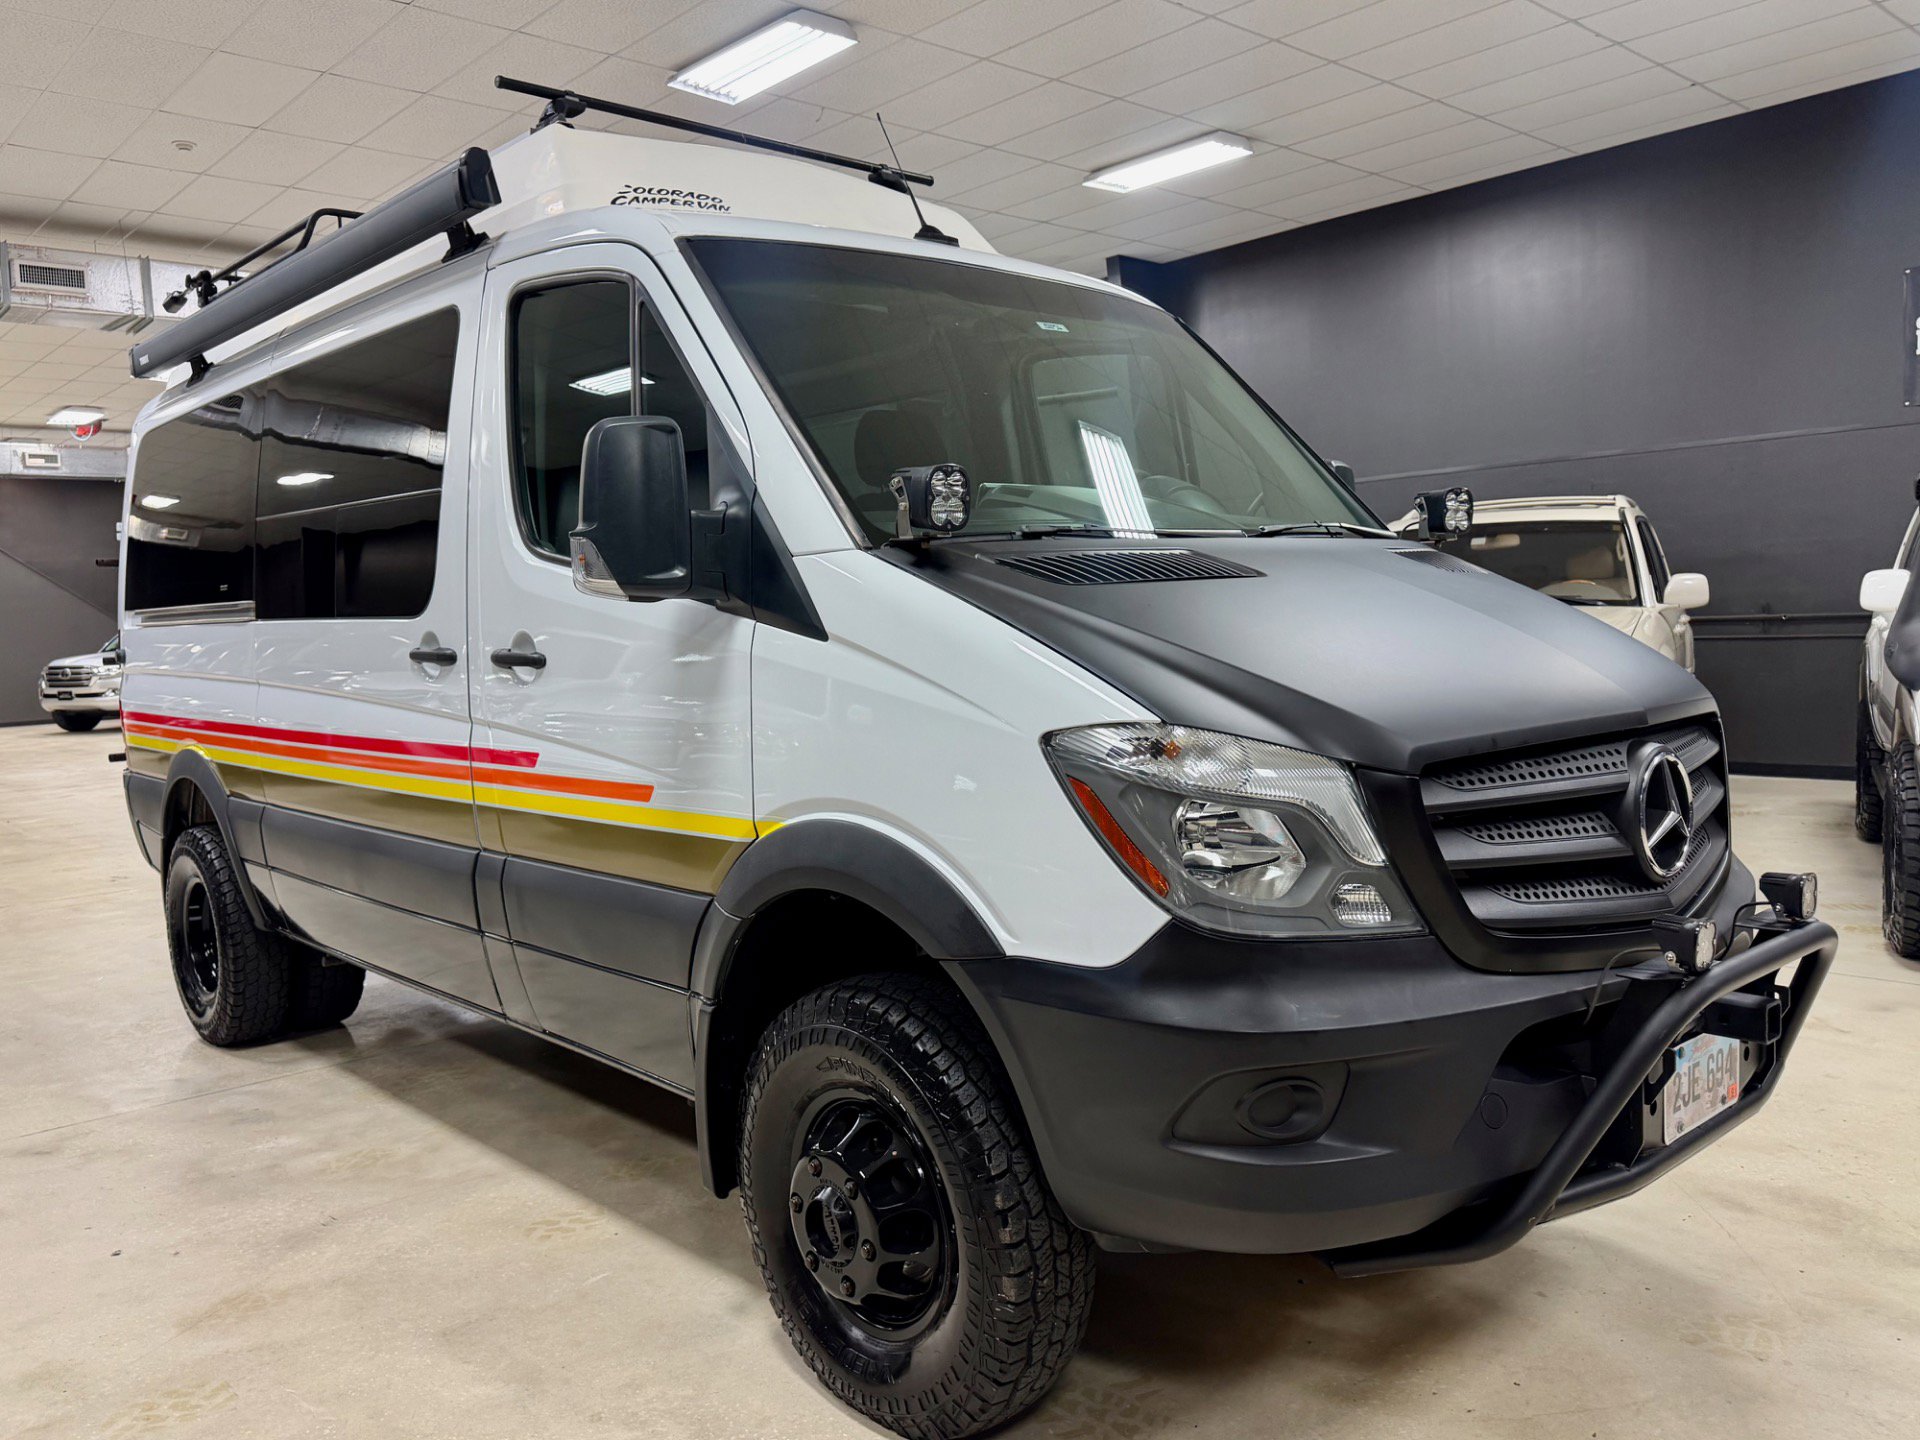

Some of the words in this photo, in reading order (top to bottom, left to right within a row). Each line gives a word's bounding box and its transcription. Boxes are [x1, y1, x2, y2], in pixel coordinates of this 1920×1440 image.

[610, 196, 731, 212] CAMPERVAN
[617, 184, 724, 204] COLORADO
[1673, 1061, 1701, 1114] 2JE
[1706, 1043, 1733, 1093] 694
